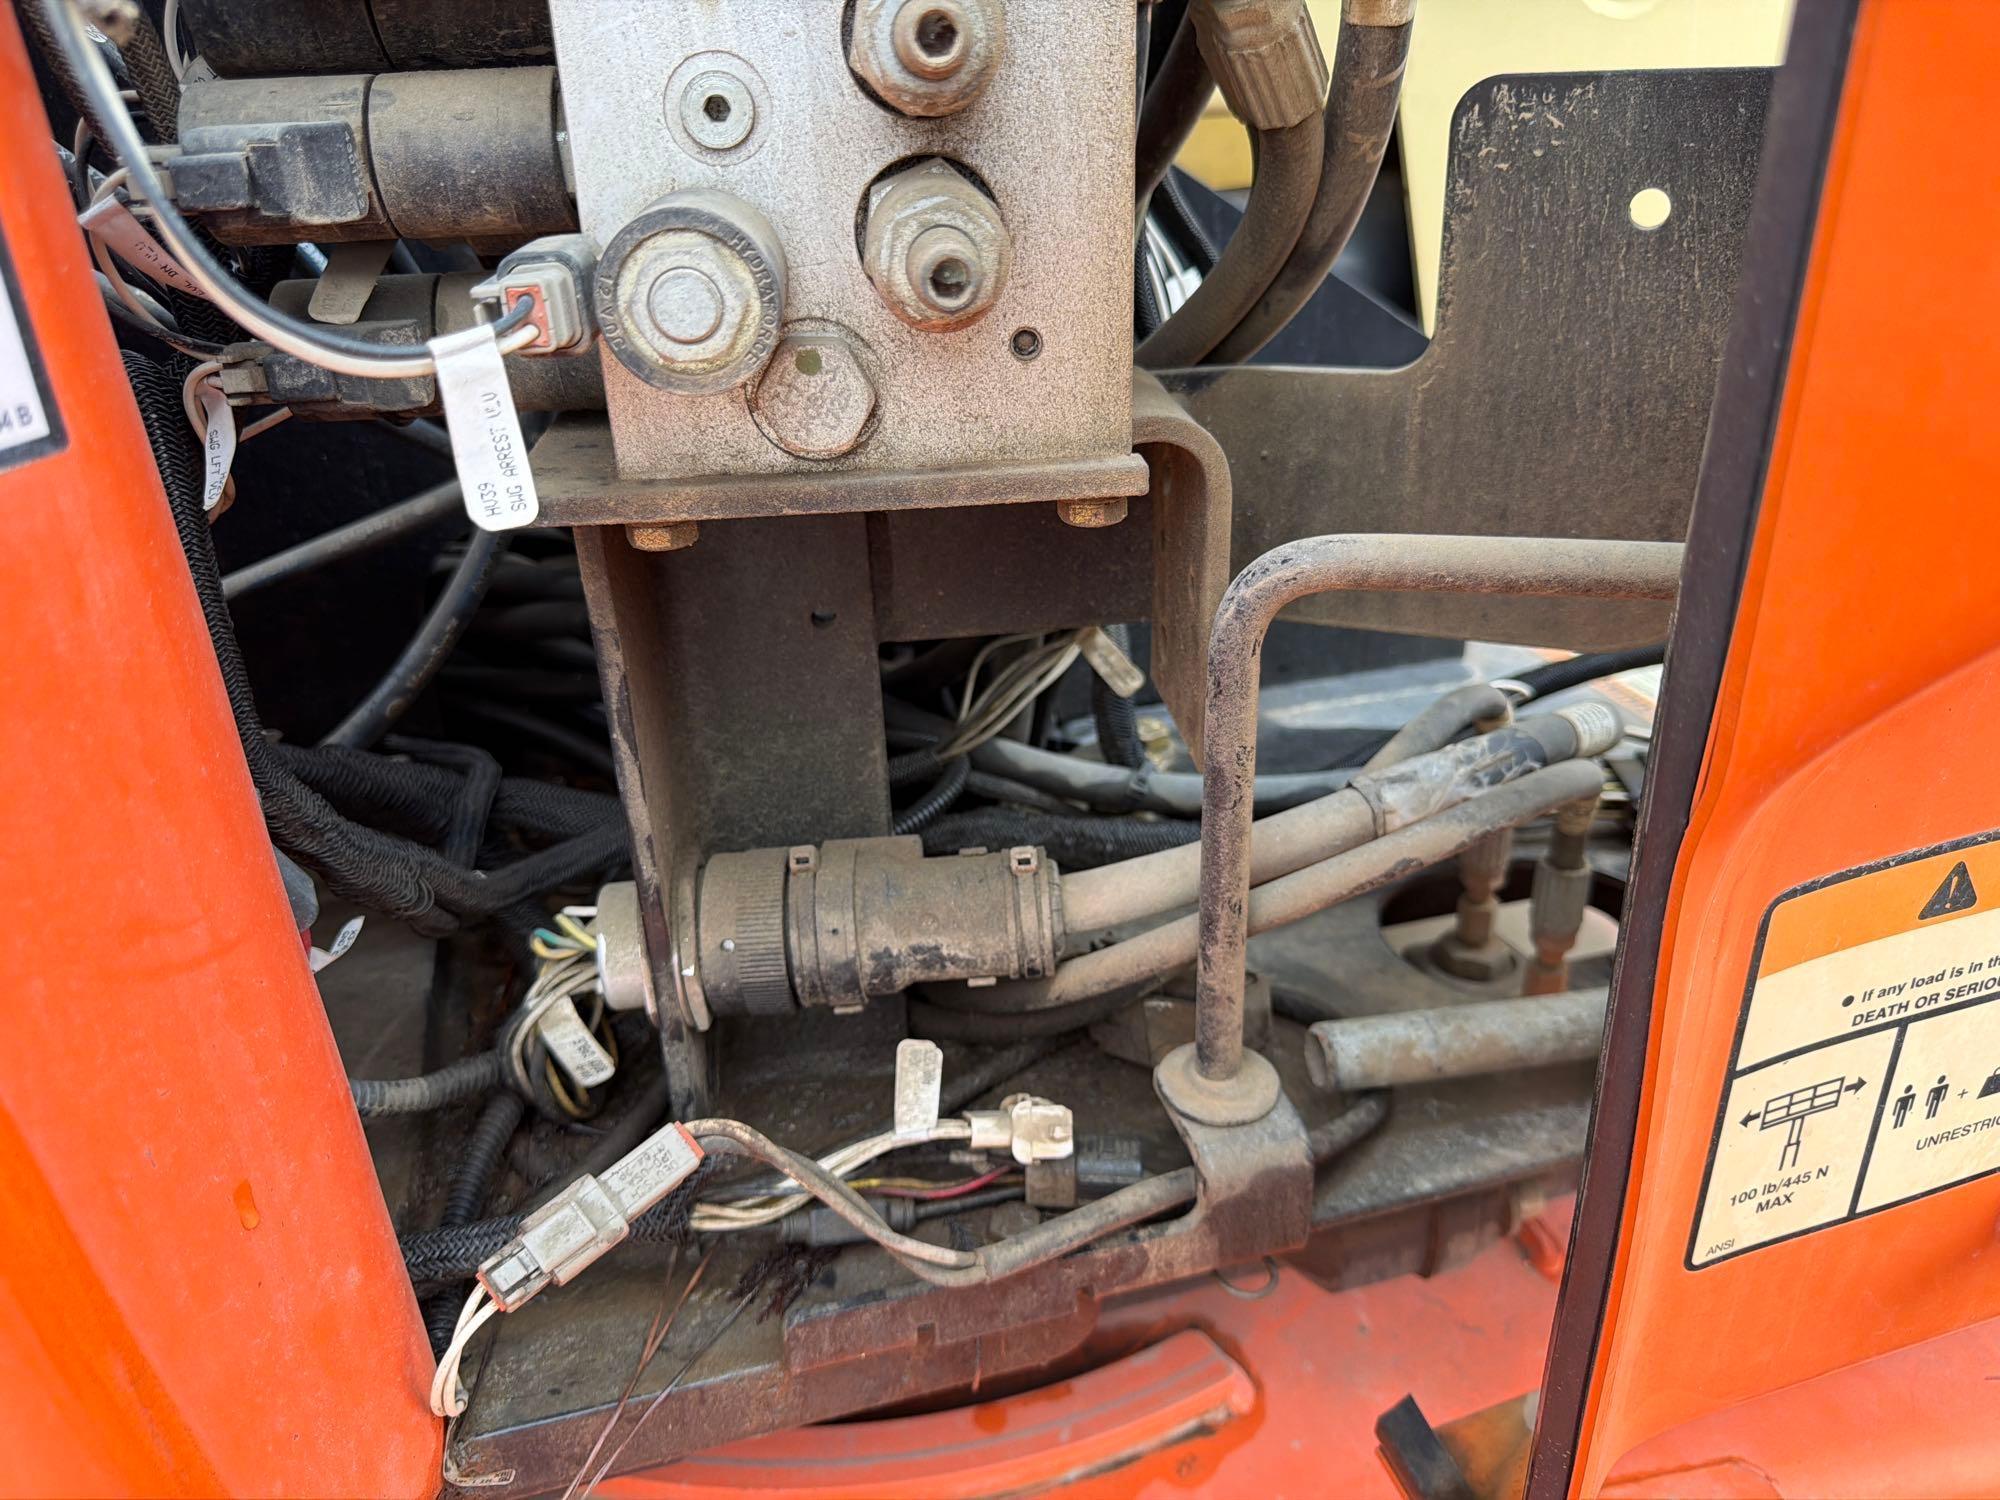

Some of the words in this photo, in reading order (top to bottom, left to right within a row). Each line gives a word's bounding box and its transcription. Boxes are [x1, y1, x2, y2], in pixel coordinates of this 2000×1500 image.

[160, 264, 179, 278] DN
[208, 429, 221, 451] SWG
[489, 427, 519, 478] ARREST
[210, 455, 221, 475] LFT
[1861, 989, 1875, 1003] If
[1877, 982, 1907, 999] any
[1910, 969, 1947, 990] load
[1949, 966, 1964, 980] is
[1968, 961, 1983, 975] in
[1851, 1000, 1910, 1027] DEATH
[1914, 992, 1941, 1009] OR
[1729, 1187, 1757, 1207] 100
[1762, 1172, 1812, 1197] lb/445
[1816, 1165, 1830, 1180] N
[1755, 1191, 1795, 1214] MAX
[1705, 1238, 1736, 1257] ANSI
